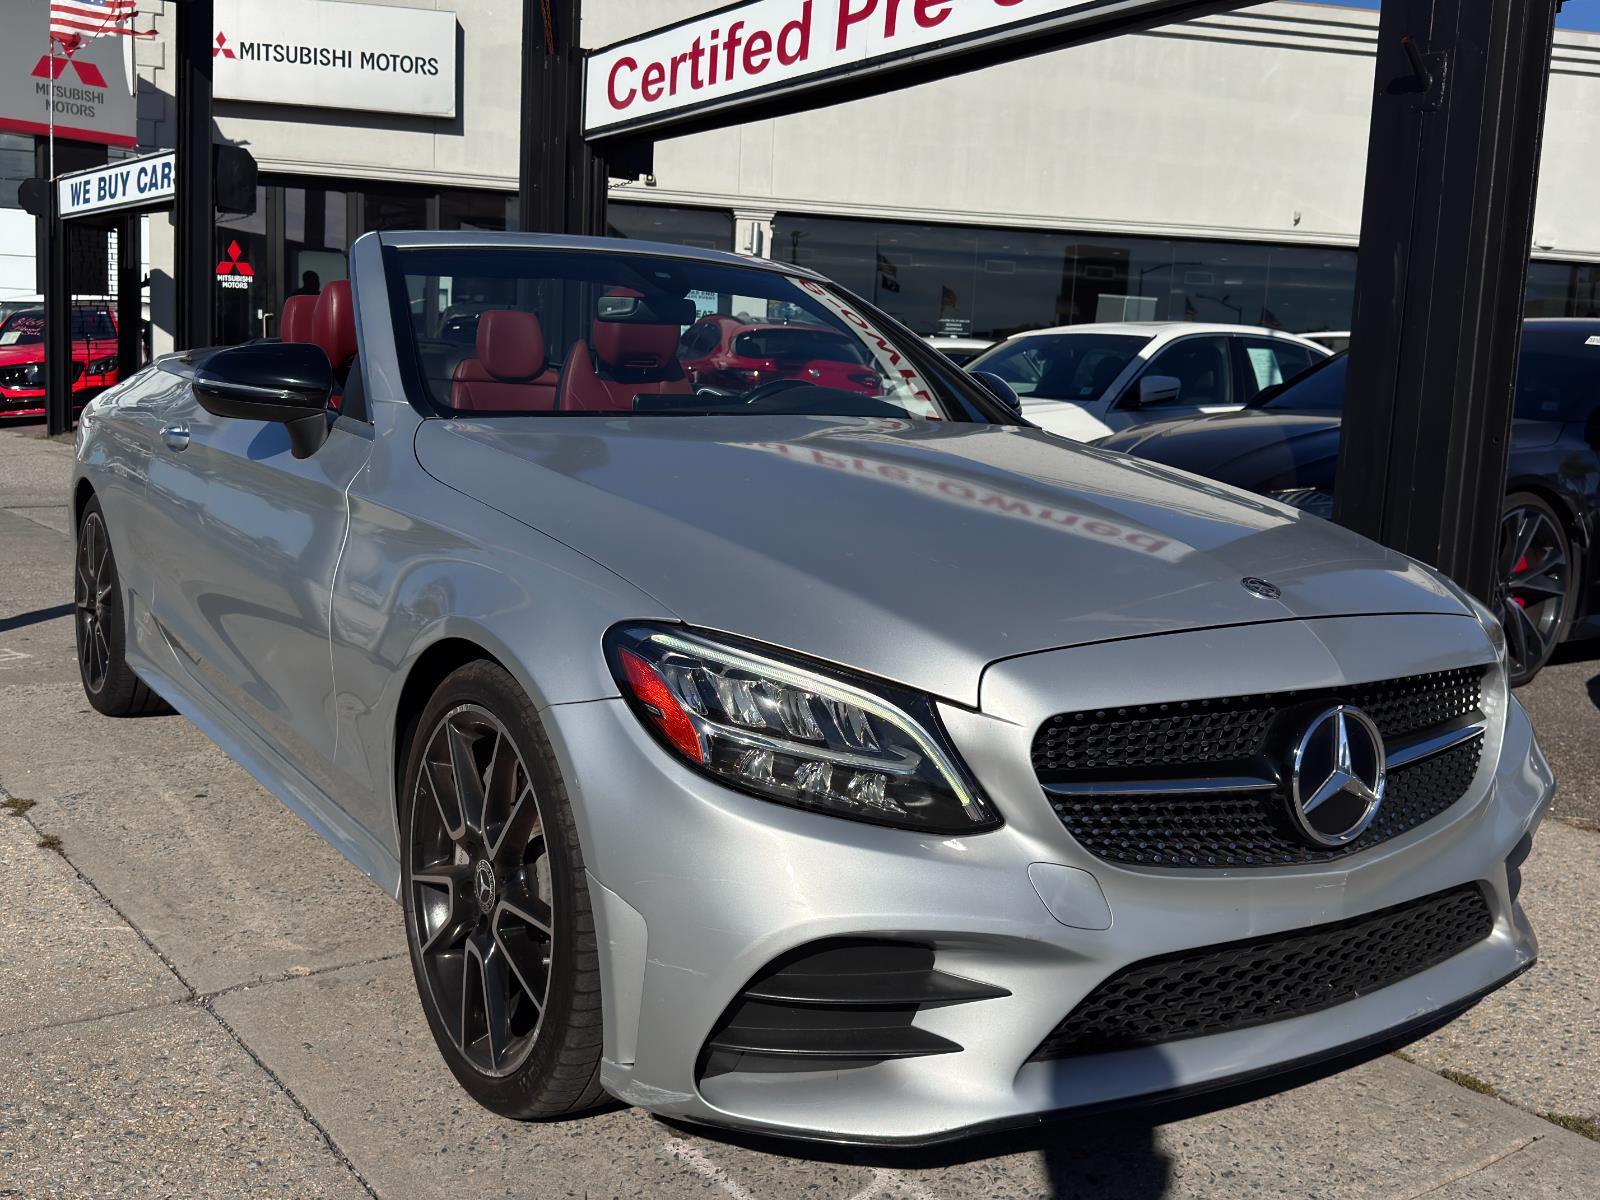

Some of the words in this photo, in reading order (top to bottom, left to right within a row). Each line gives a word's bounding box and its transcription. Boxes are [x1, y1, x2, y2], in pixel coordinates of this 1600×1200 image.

[239, 41, 352, 69] MITSUBISHI
[360, 51, 439, 76] MOTORS
[607, 0, 812, 110] Certifed
[35, 82, 104, 104] MITSUBISHI
[45, 98, 96, 118] MOTORS
[71, 179, 91, 207] WE
[97, 170, 131, 202] BUY
[136, 161, 176, 194] CAR
[216, 274, 253, 283] MITSUBISHI
[222, 281, 248, 289] MOTORS
